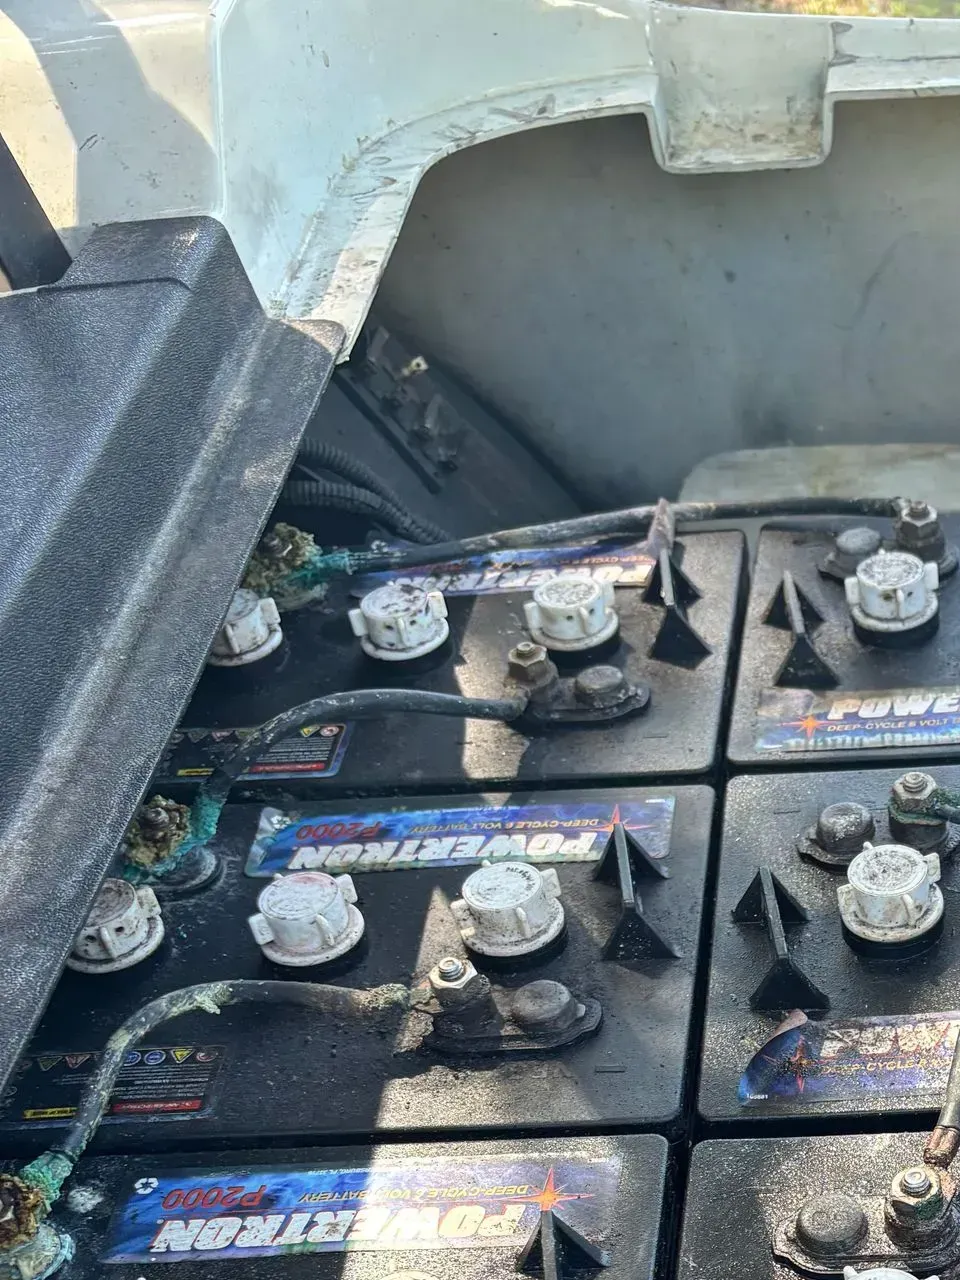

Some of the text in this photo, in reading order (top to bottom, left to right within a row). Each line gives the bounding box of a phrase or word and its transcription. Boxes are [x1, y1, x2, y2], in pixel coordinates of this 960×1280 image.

[295, 821, 383, 841] P2000
[513, 818, 599, 831] DEEP-CYCLE
[287, 832, 598, 870] POWERTRON
[161, 1184, 268, 1211] P2000
[297, 1184, 530, 1203] DEEP-CYCLE BATTERY
[150, 1204, 527, 1253] POWERTRON
